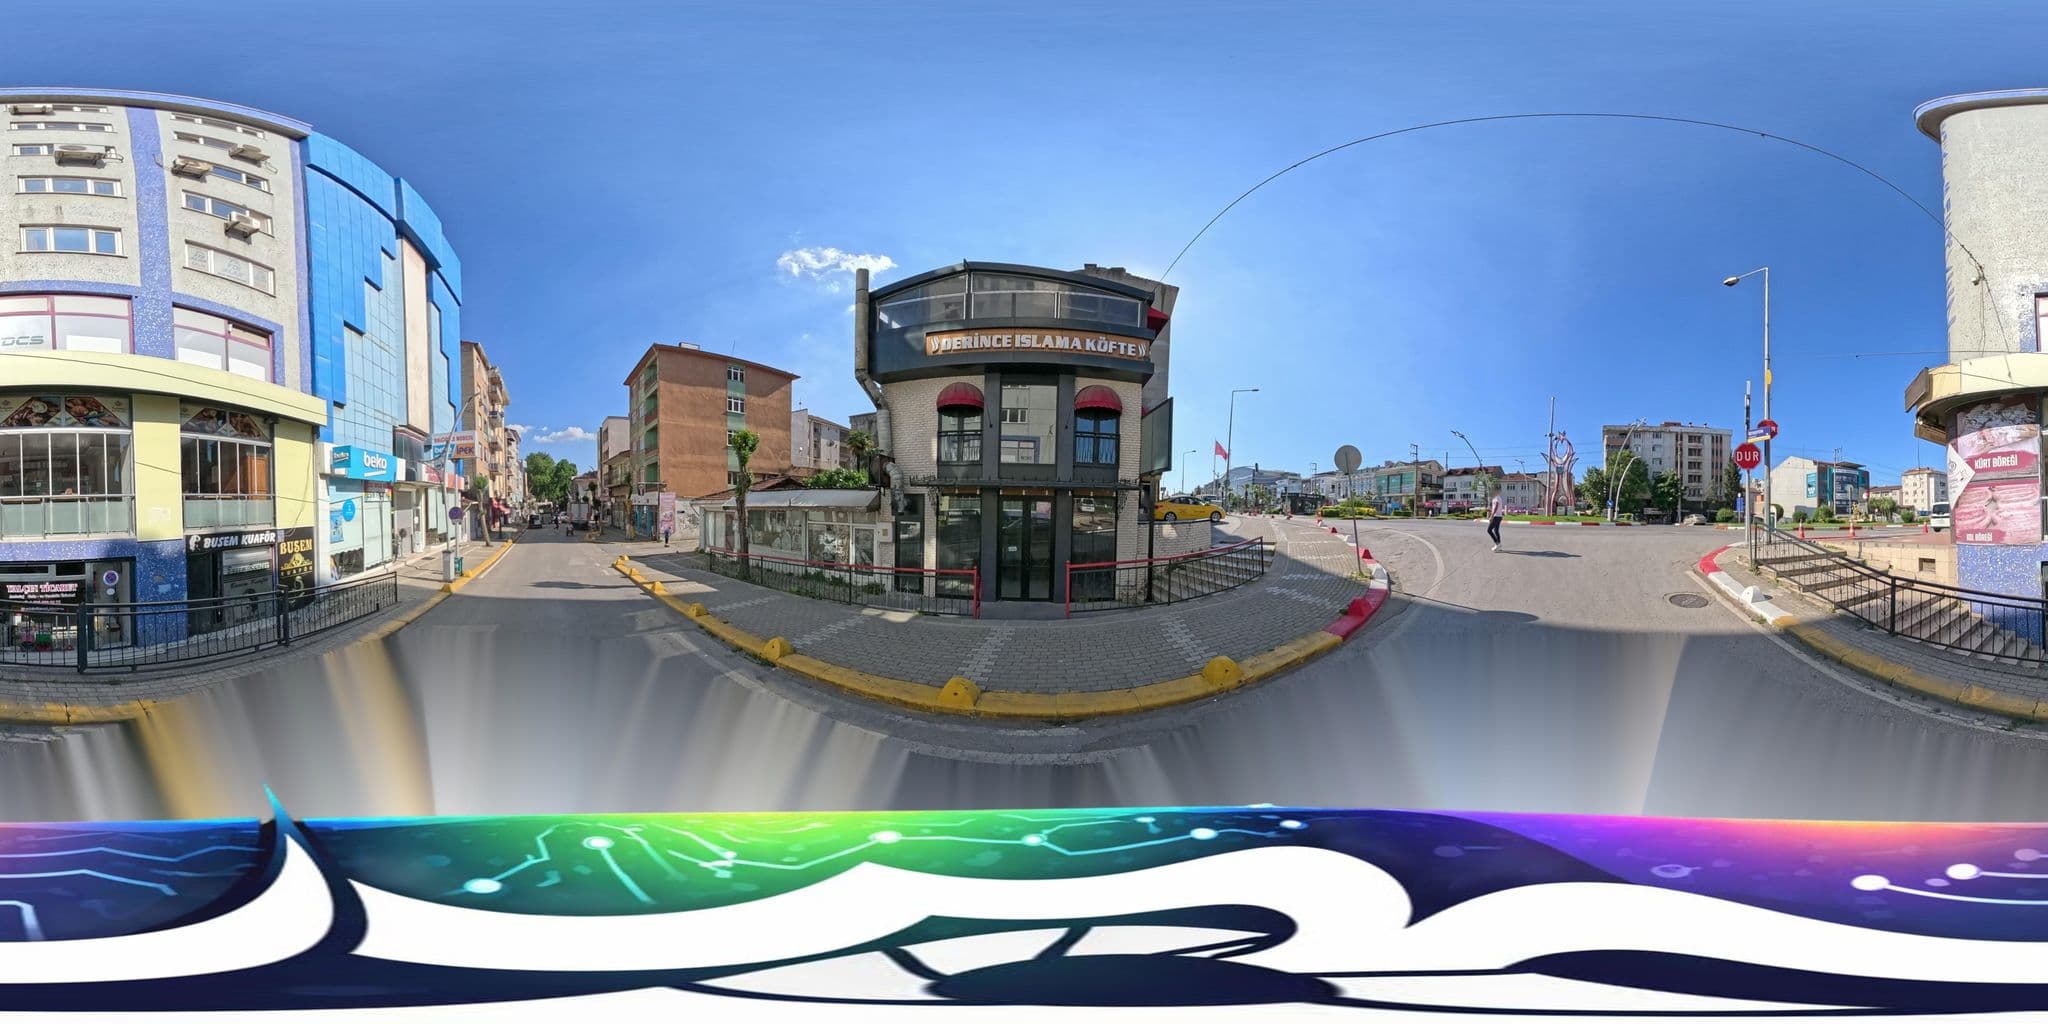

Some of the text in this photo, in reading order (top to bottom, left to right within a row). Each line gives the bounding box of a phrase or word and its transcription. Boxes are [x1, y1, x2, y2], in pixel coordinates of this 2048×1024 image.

[941, 332, 1136, 357] DERİNCE ISLAMA KÖFTE
[363, 450, 387, 469] beko
[1736, 451, 1759, 462] DUR
[1974, 453, 2018, 470] KÜRT BÖREĞİ
[203, 531, 276, 548] BUSEM KUAFÖR
[280, 538, 313, 555] BUSEM
